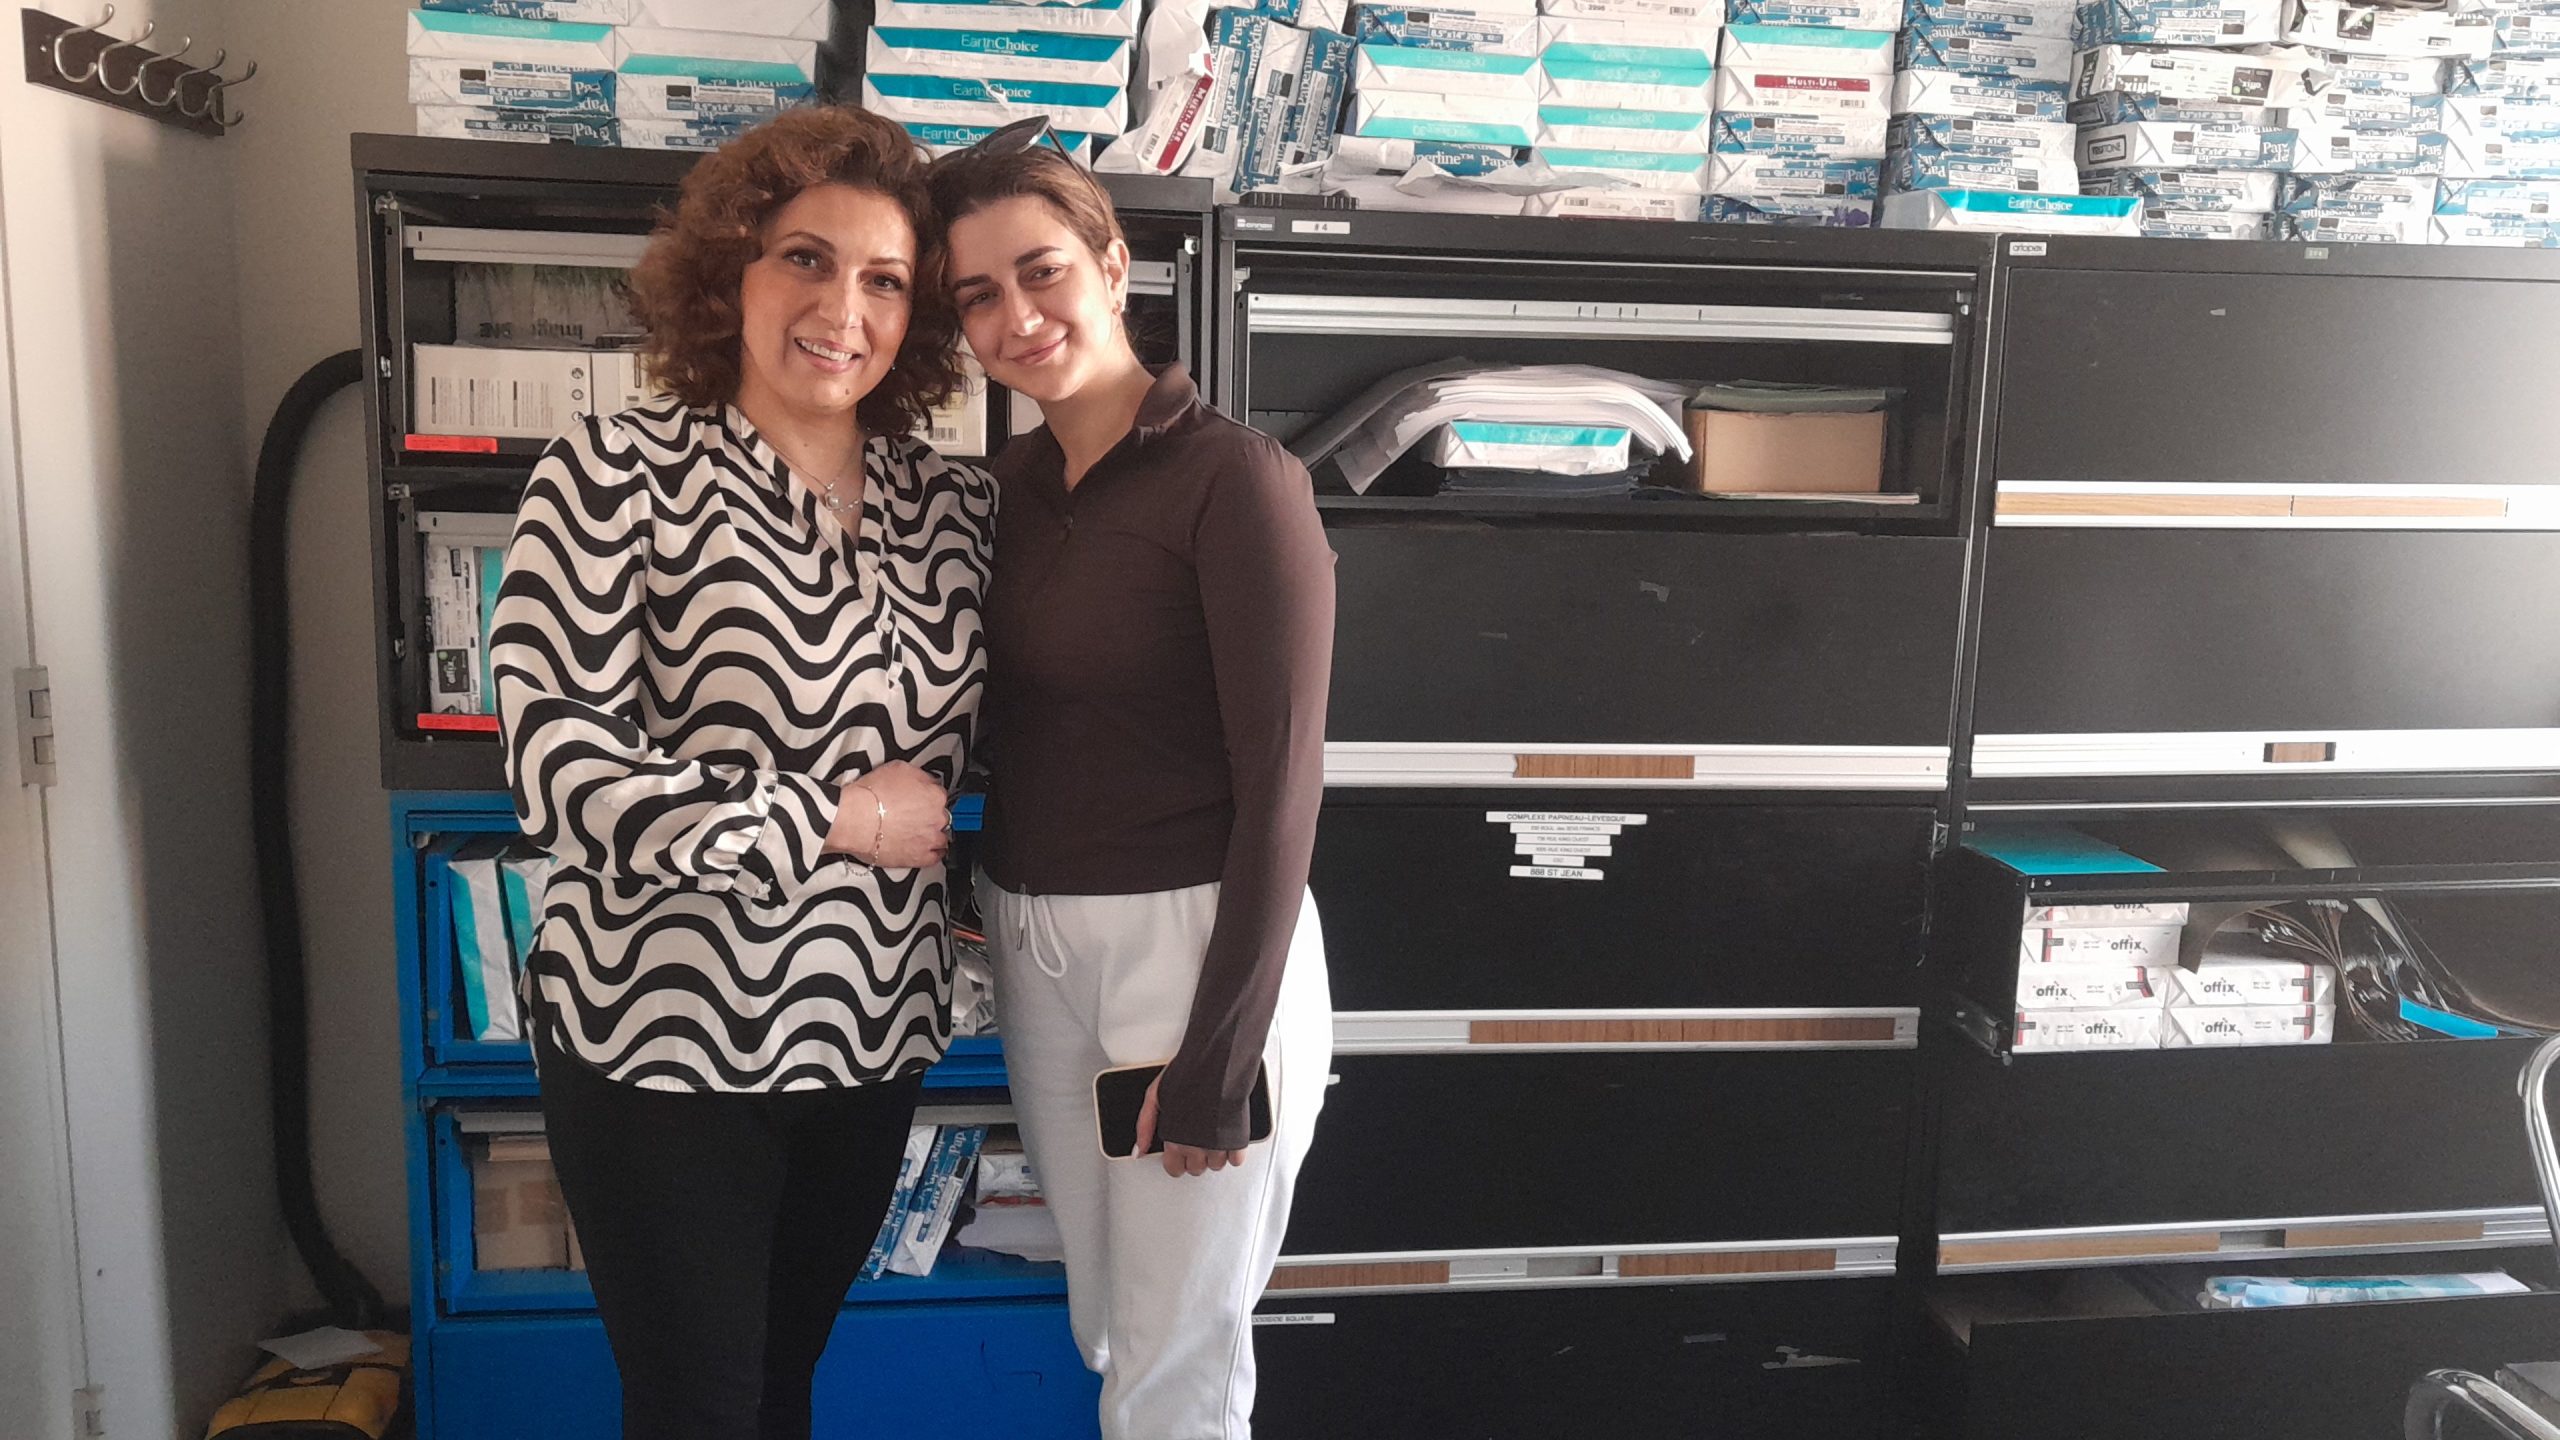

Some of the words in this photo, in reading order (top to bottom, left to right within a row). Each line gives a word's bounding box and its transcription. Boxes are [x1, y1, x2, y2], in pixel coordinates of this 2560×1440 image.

[961, 34, 1039, 52] EarthChoice
[922, 126, 989, 140] EarthChoi
[2008, 196, 2074, 211] EarthChoice
[1560, 869, 1583, 878] JEAN
[2109, 936, 2143, 951] offix
[2035, 983, 2068, 998] offix
[2203, 979, 2236, 994] offix
[2084, 1020, 2117, 1036] offix
[2204, 1019, 2237, 1034] offix
